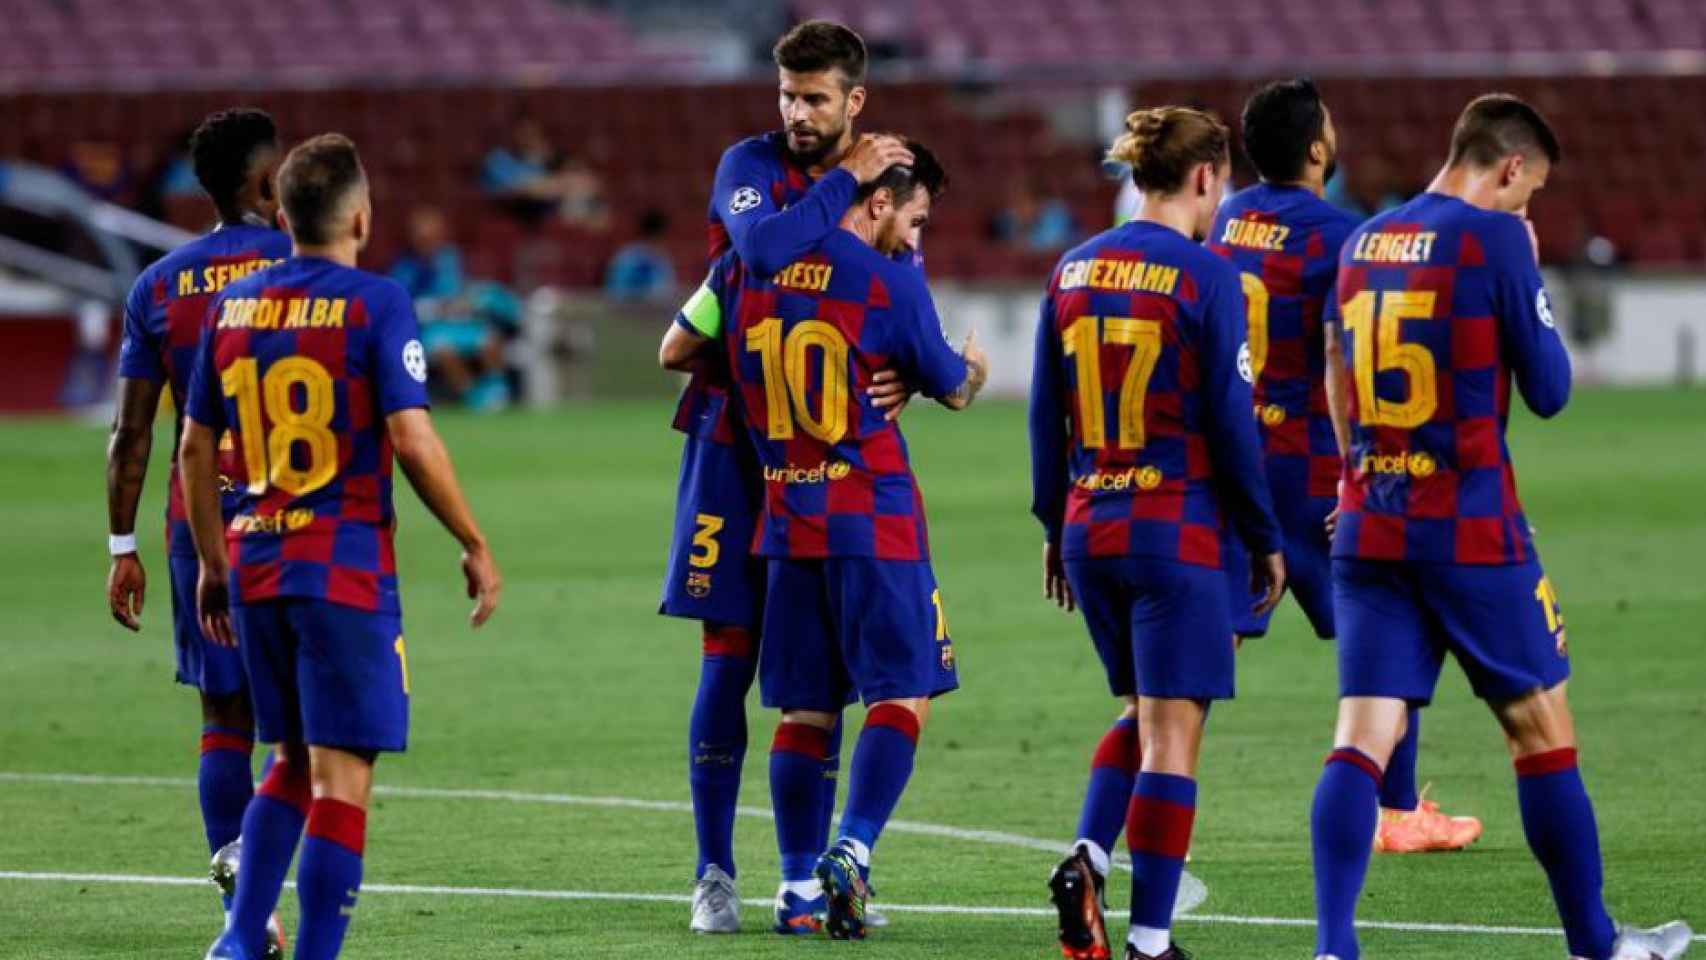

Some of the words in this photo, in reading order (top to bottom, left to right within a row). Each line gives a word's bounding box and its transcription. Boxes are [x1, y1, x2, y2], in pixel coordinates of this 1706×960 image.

[1221, 214, 1291, 251] SUÁREZ
[1353, 232, 1437, 262] LENGLET
[178, 268, 200, 296] M.
[203, 257, 286, 292] SEME
[1060, 258, 1179, 295] GRIEZMANN
[217, 298, 283, 328] JORDI
[283, 297, 346, 328] ALBA
[1341, 290, 1437, 428] 15
[746, 317, 848, 445] 10
[1062, 316, 1162, 450] 17
[221, 356, 338, 496] 18
[763, 460, 827, 484] unicef
[1360, 450, 1408, 474] nicef
[689, 513, 724, 568] 3
[1535, 577, 1563, 633] 1
